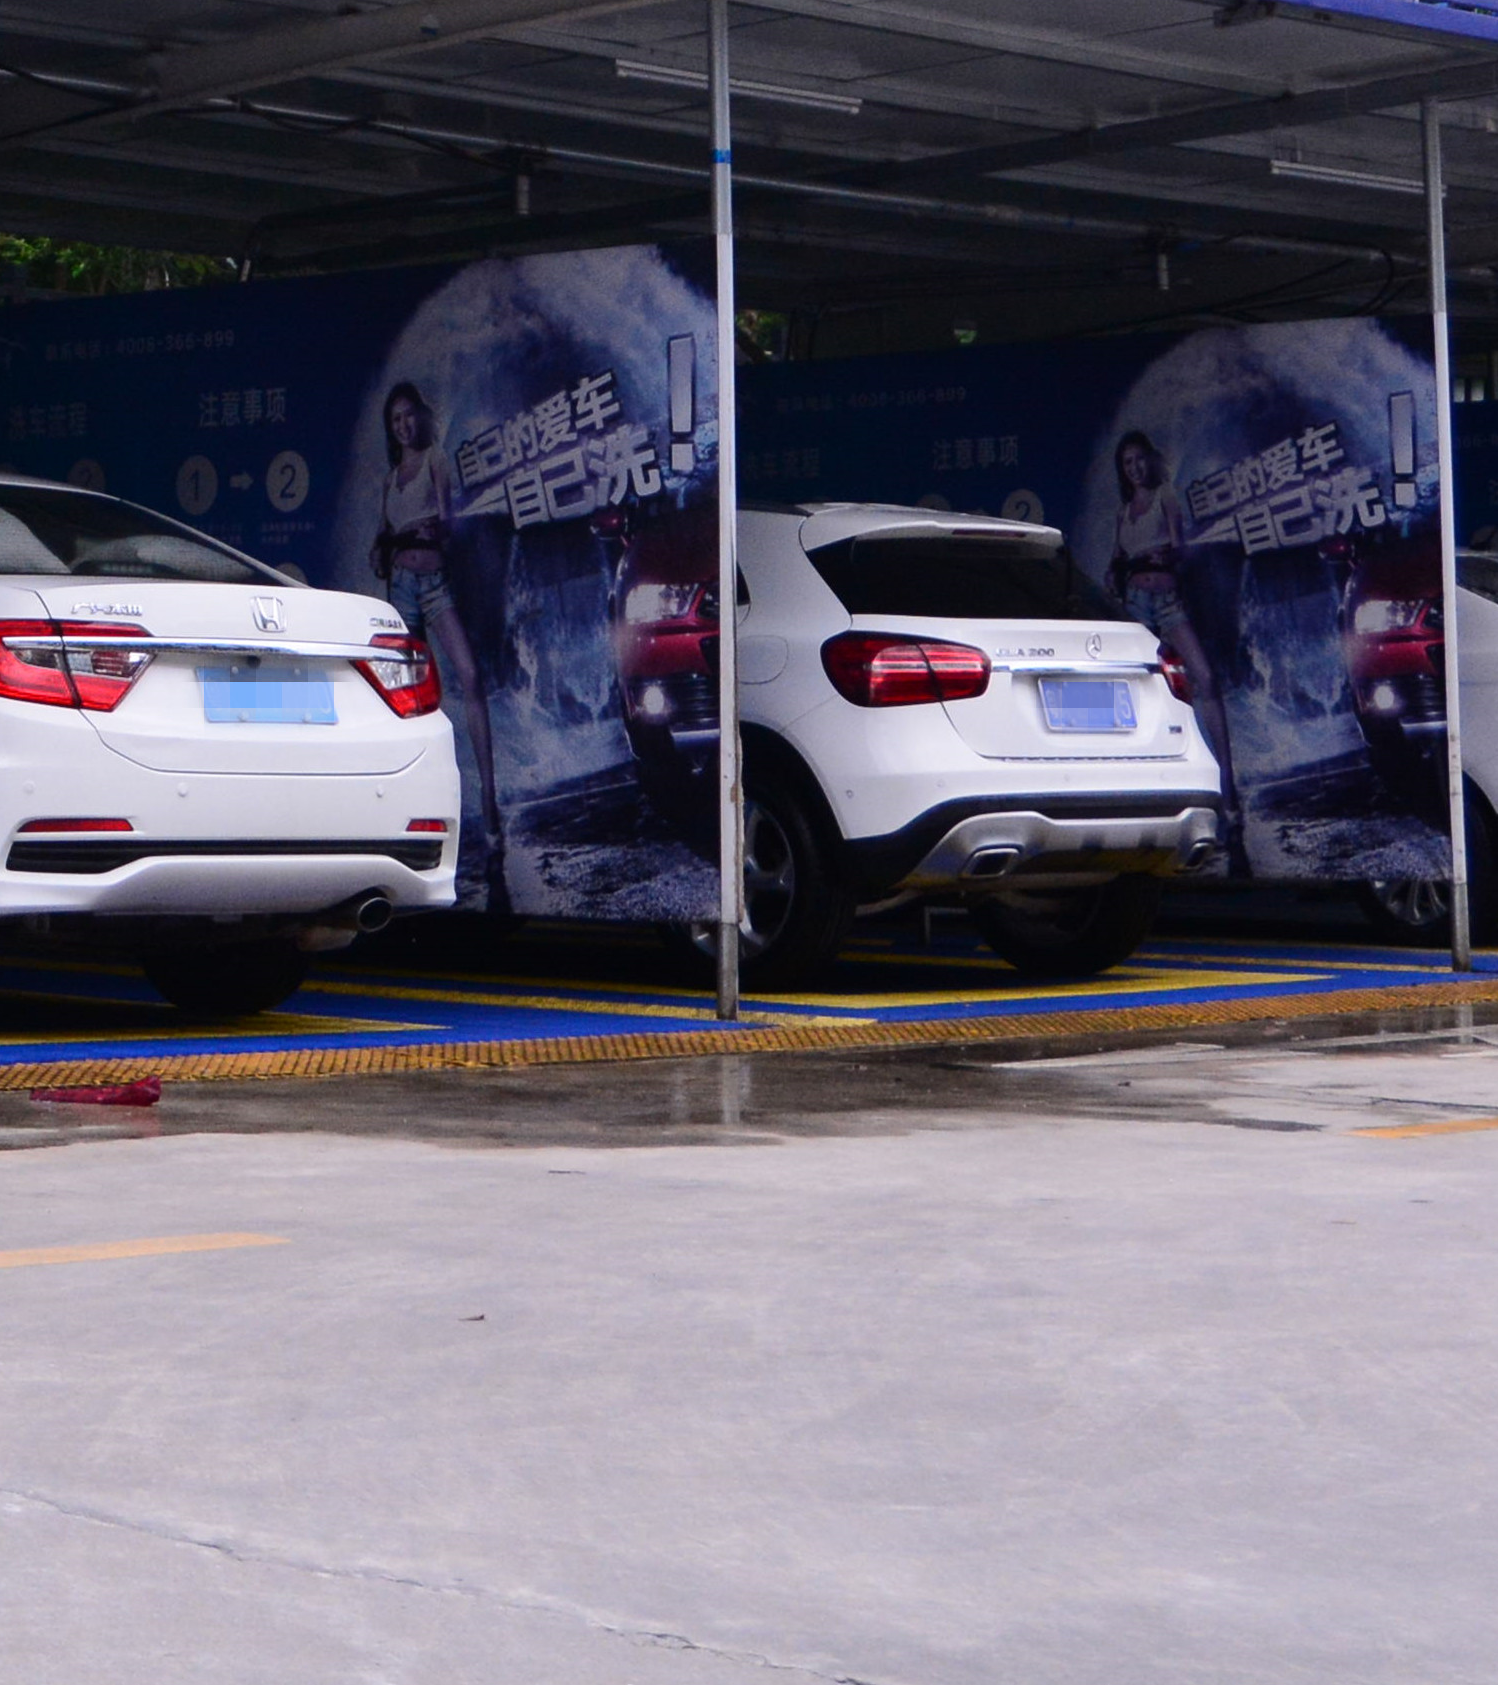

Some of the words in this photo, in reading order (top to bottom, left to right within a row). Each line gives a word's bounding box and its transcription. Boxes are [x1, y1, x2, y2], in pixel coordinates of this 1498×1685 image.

[198, 387, 286, 427] 注意事项
[456, 372, 620, 489] 自己的爱车
[932, 436, 1019, 470] 注意事项
[1188, 421, 1344, 518] 自己的爱车
